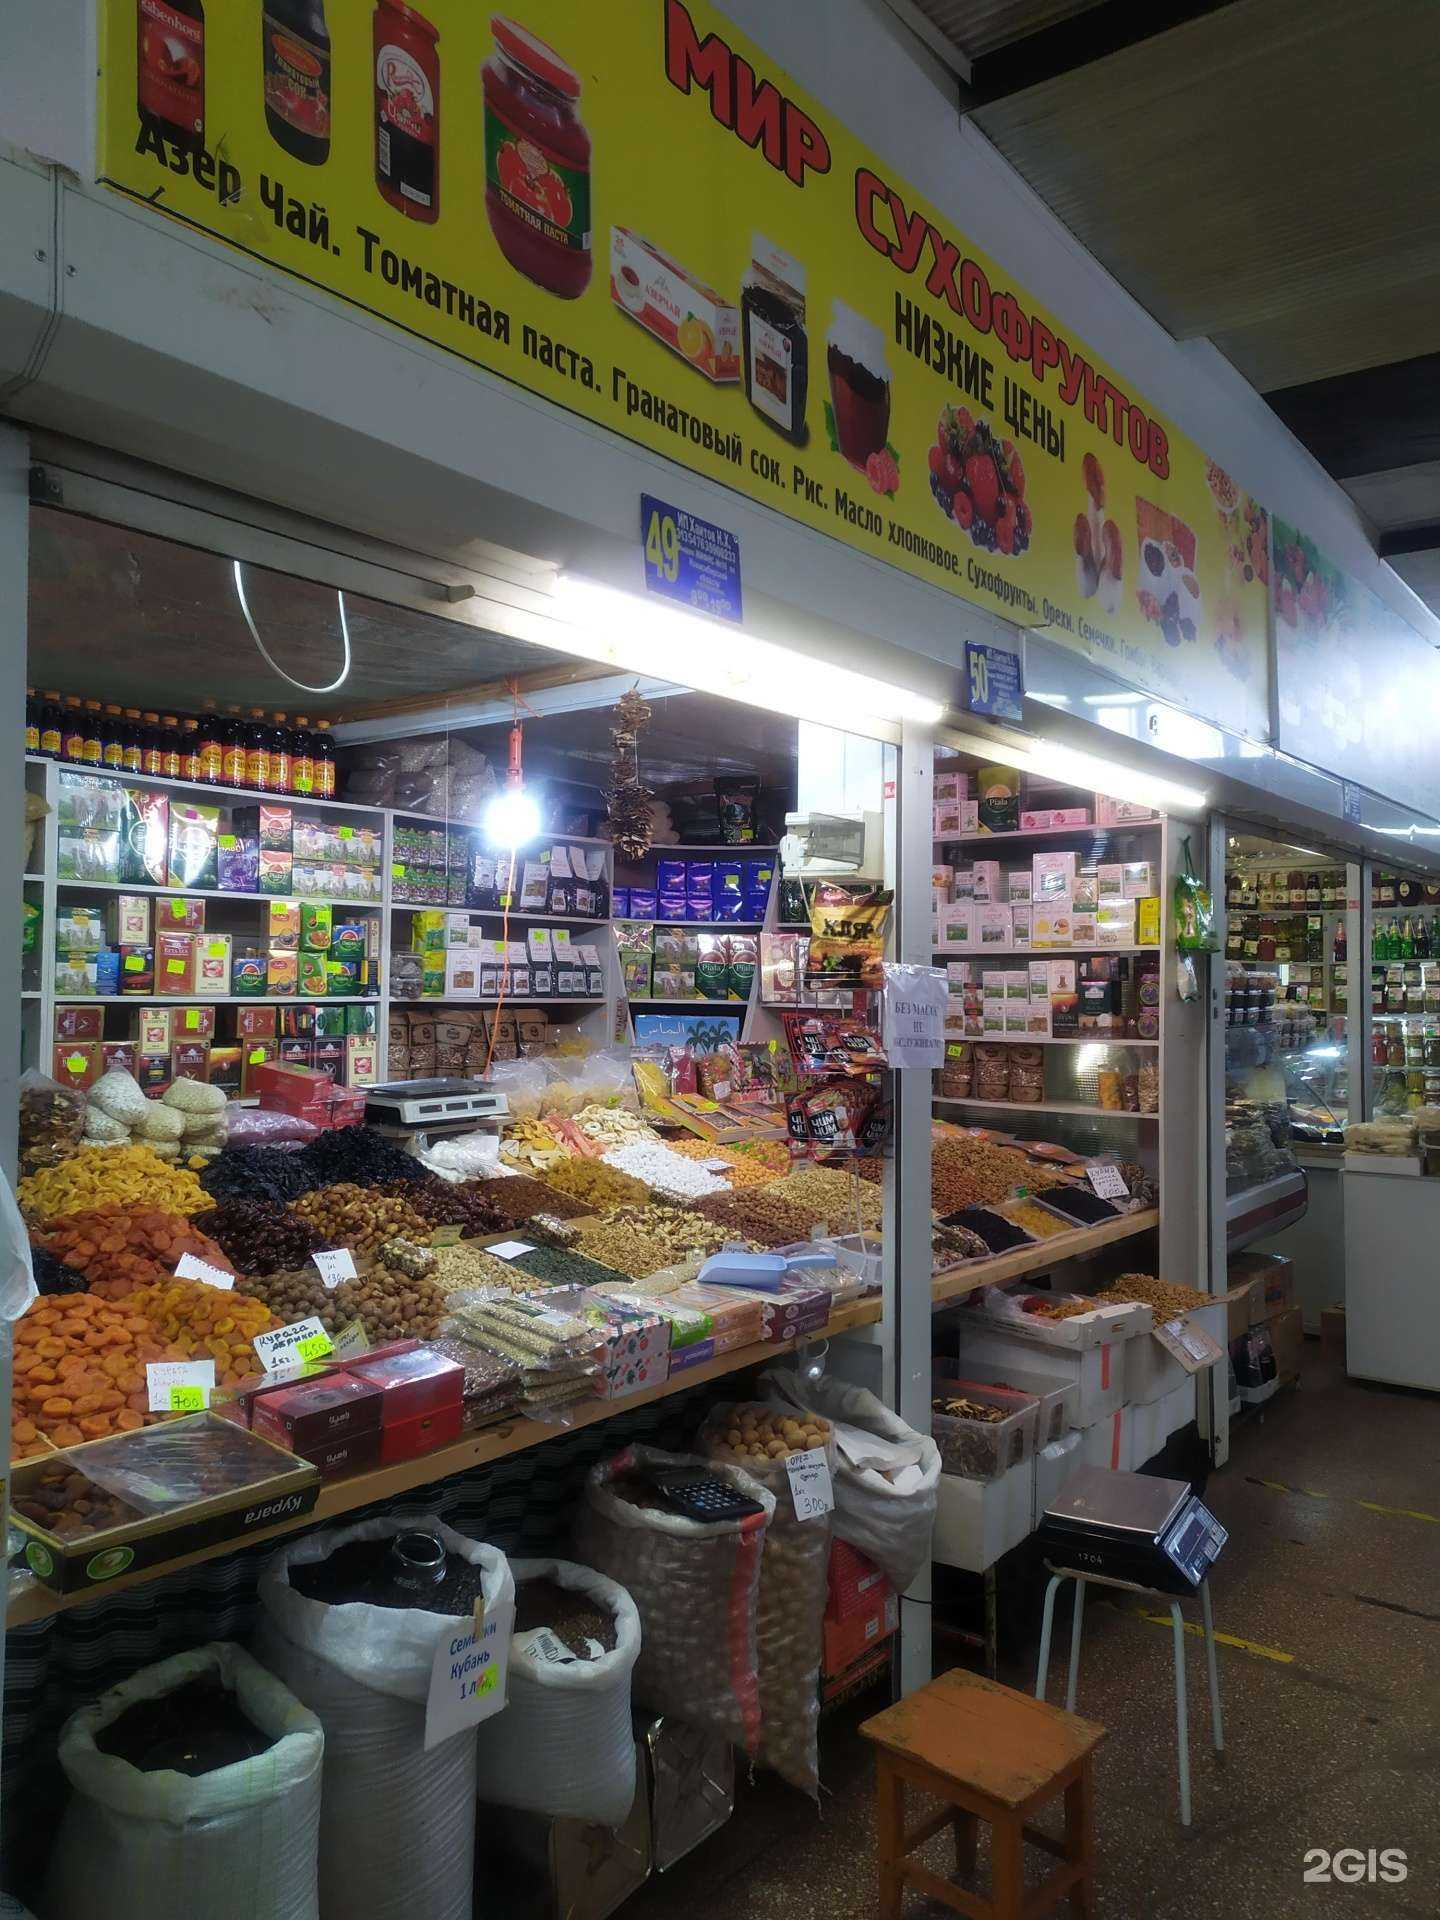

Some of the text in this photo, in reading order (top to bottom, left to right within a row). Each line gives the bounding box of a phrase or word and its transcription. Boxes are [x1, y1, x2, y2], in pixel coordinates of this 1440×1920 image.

[664, 0, 1169, 480] МИР СУХОФРУКТОВ
[134, 114, 242, 207] Азер
[356, 225, 510, 345] Томатная
[522, 324, 602, 393] паста.
[611, 368, 743, 467] Гранатовый
[750, 445, 786, 489] сок.
[793, 466, 828, 511] Рис.
[835, 487, 883, 538] Масло
[888, 523, 963, 578] хлопковое.
[967, 557, 1039, 615] Сухофрукты.
[1043, 599, 1075, 633] Орехи.
[895, 291, 1065, 463] НИЗКИЕ ЦЕНЫ
[646, 510, 680, 583] 49
[970, 651, 988, 704] 50
[244, 1495, 303, 1525] Курага
[450, 1622, 497, 1656] Семеки
[450, 1651, 491, 1680] Кубань
